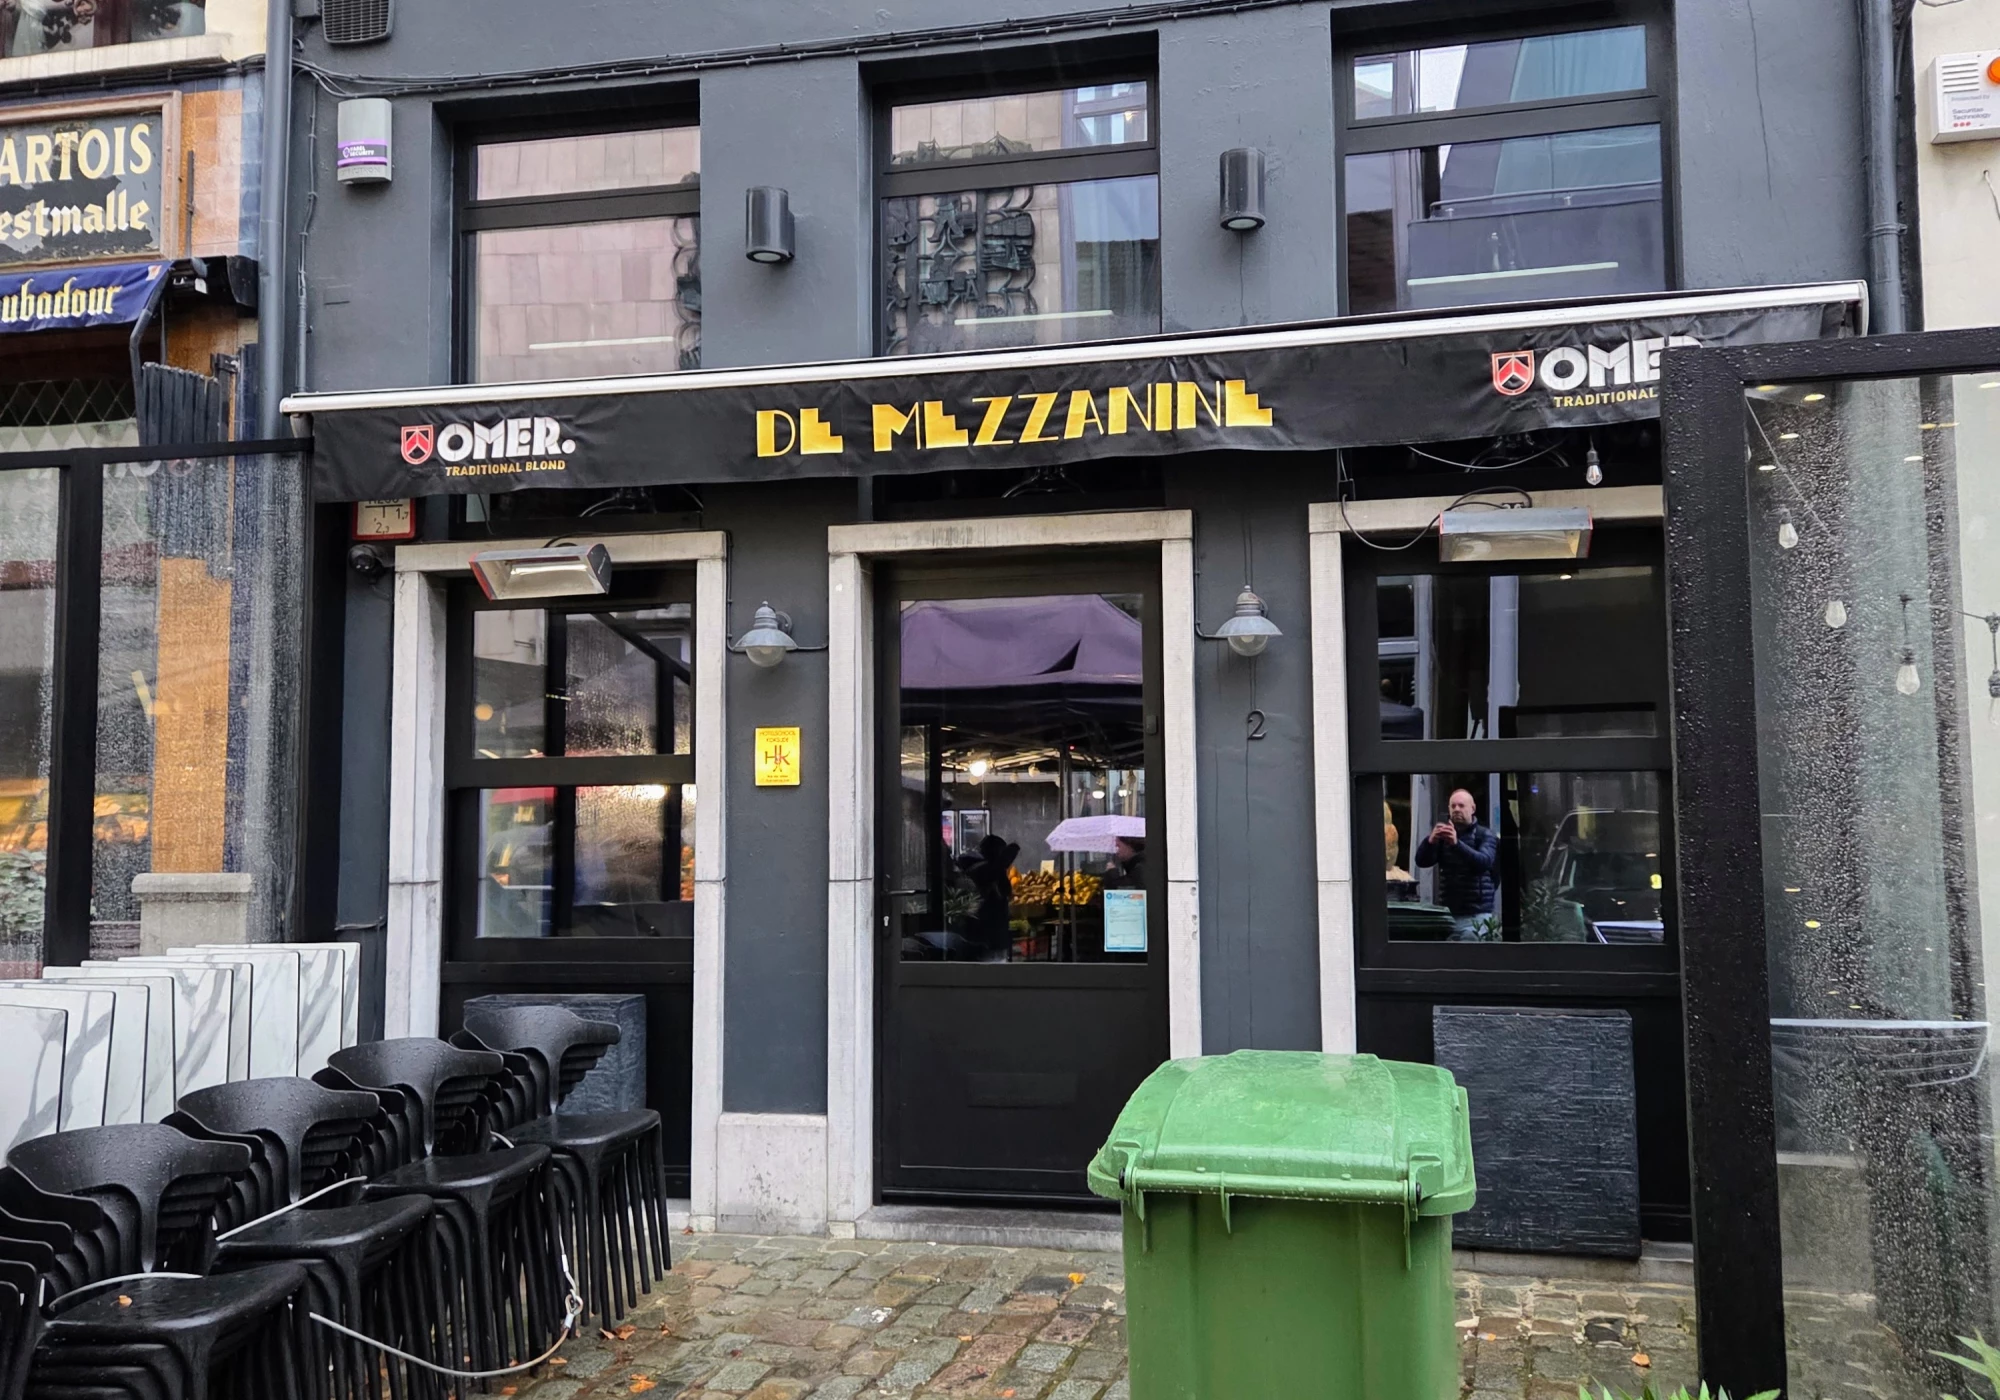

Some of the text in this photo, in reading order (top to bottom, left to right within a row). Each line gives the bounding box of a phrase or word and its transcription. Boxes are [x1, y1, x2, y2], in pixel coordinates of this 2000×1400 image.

[0, 123, 151, 185] ARTOIS
[0, 189, 150, 240] estmalle
[1, 276, 123, 323] ubadour
[1540, 335, 1703, 391] OME
[756, 379, 1273, 457] DE MEZZANINE
[1553, 388, 1658, 408] TRADITIONAL
[445, 460, 566, 477] TRADITIONAL BLOND
[1247, 709, 1267, 741] 2
